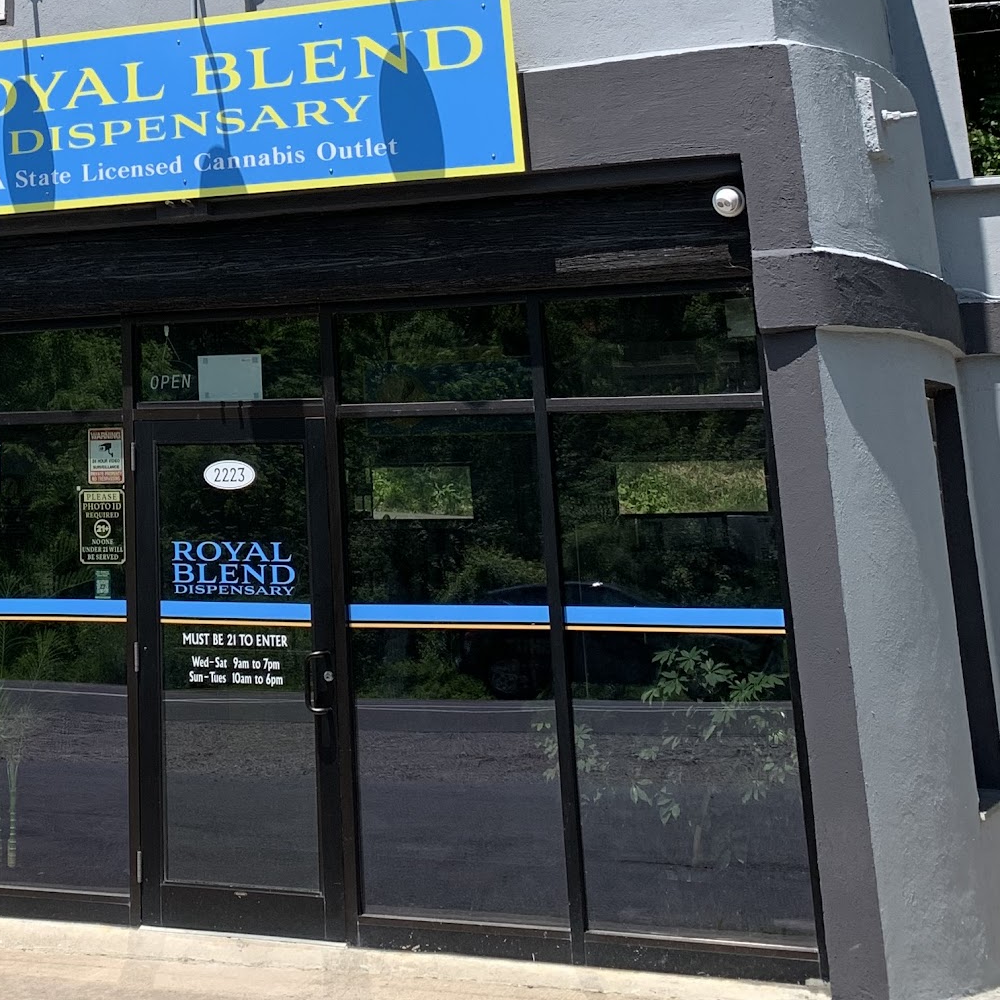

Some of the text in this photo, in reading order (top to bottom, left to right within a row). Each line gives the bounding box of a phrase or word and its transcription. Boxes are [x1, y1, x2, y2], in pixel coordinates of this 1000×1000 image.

[190, 25, 483, 97] BLEND
[8, 95, 372, 156] DISPENSARY
[15, 168, 71, 188] State
[82, 154, 182, 182] Licensed
[193, 145, 305, 173] Cannabis
[316, 137, 399, 162] Outlet
[150, 373, 191, 390] OPEN
[90, 431, 121, 440] WARNING
[214, 467, 245, 482] 2223
[85, 511, 119, 519] REQUIRED
[96, 524, 109, 533] 21+
[171, 540, 292, 562] ROYAL
[172, 562, 296, 585] BLEND
[174, 584, 295, 596] DISPENSARY
[182, 632, 288, 647] MUST BE 21 TO ENTER
[232, 657, 249, 669] 9am
[252, 659, 261, 670] to
[263, 658, 280, 671] 7pm
[232, 672, 252, 684] 10am
[254, 674, 263, 685] to
[265, 673, 284, 687] 6pm
